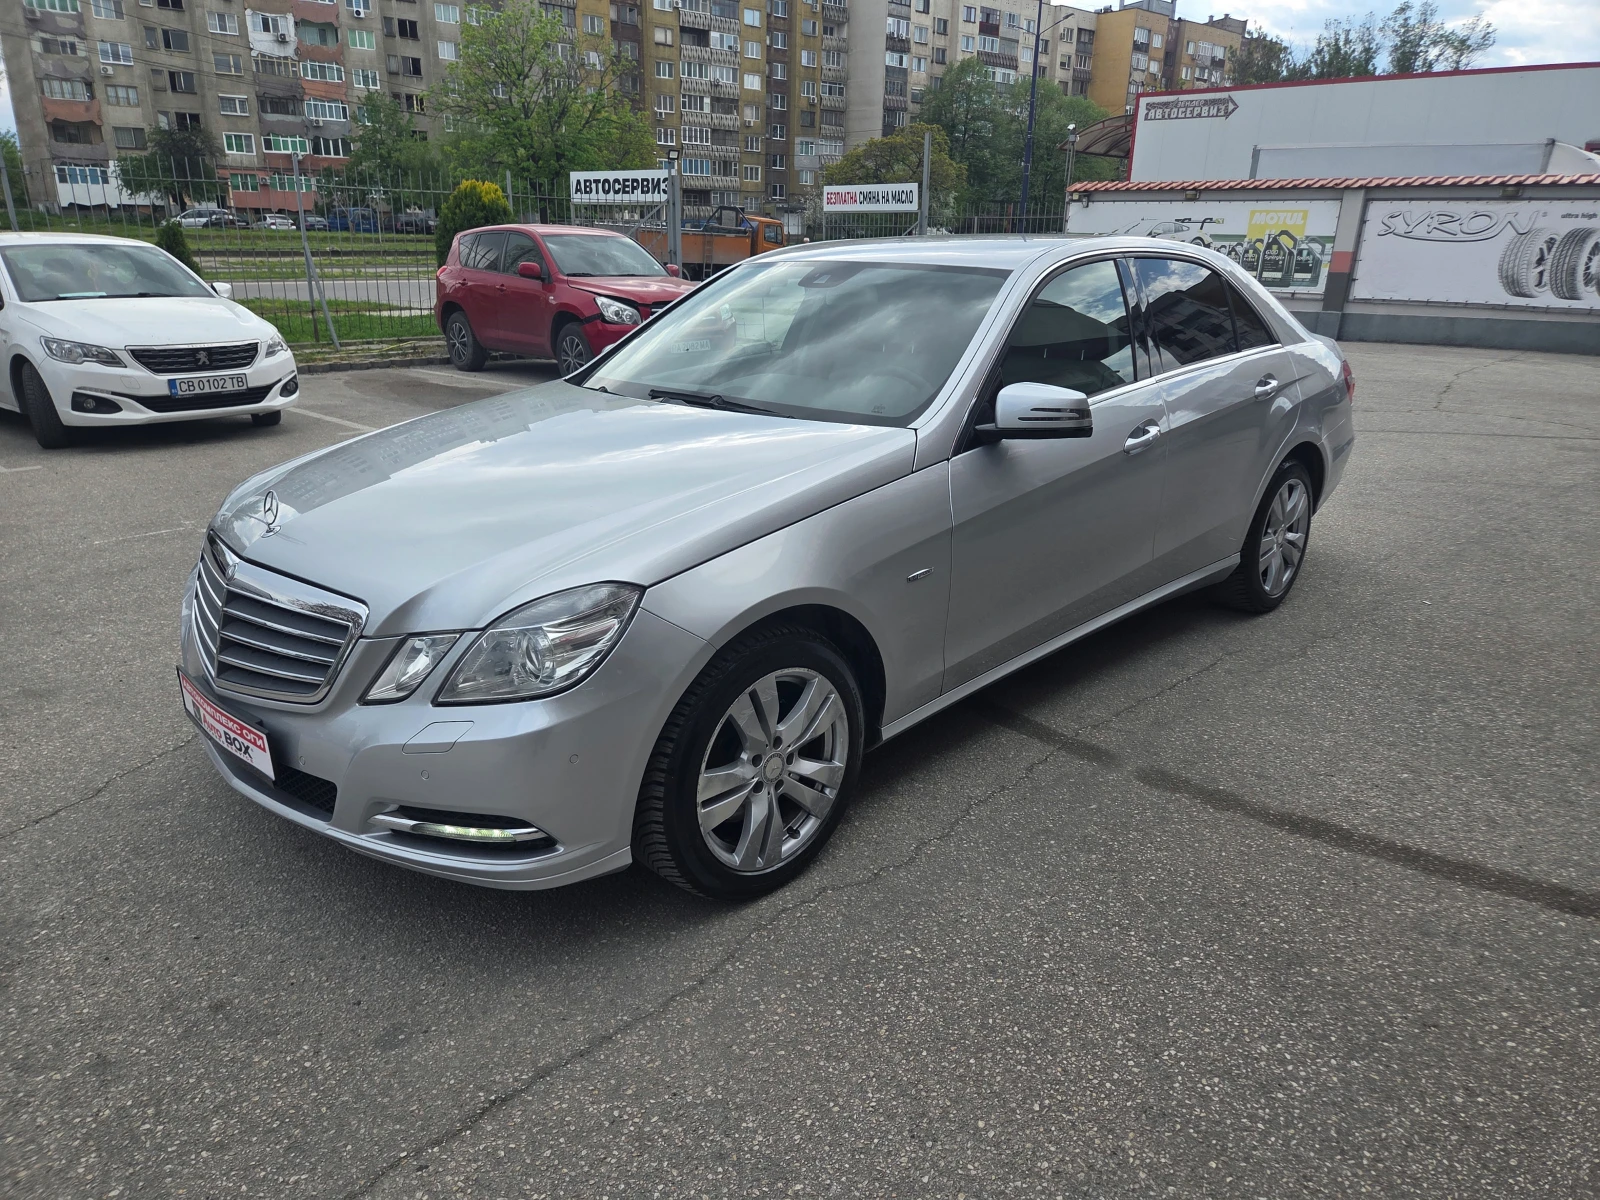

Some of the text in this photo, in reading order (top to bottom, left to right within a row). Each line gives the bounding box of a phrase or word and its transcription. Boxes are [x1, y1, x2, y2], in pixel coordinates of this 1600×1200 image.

[1148, 104, 1228, 119] АВТОСЕРВИЗ
[574, 178, 668, 195] АВТОСЕРВИЗ
[826, 189, 914, 205] БЕЗПЛАТНА СМЯНА НА МАСЛО
[1250, 212, 1305, 225] MOTUL
[1377, 211, 1539, 237] SYRON
[1581, 212, 1598, 220] high
[179, 376, 245, 393] CB 0102 TB
[223, 729, 253, 759] BOX
[242, 728, 265, 749] ОГИ
